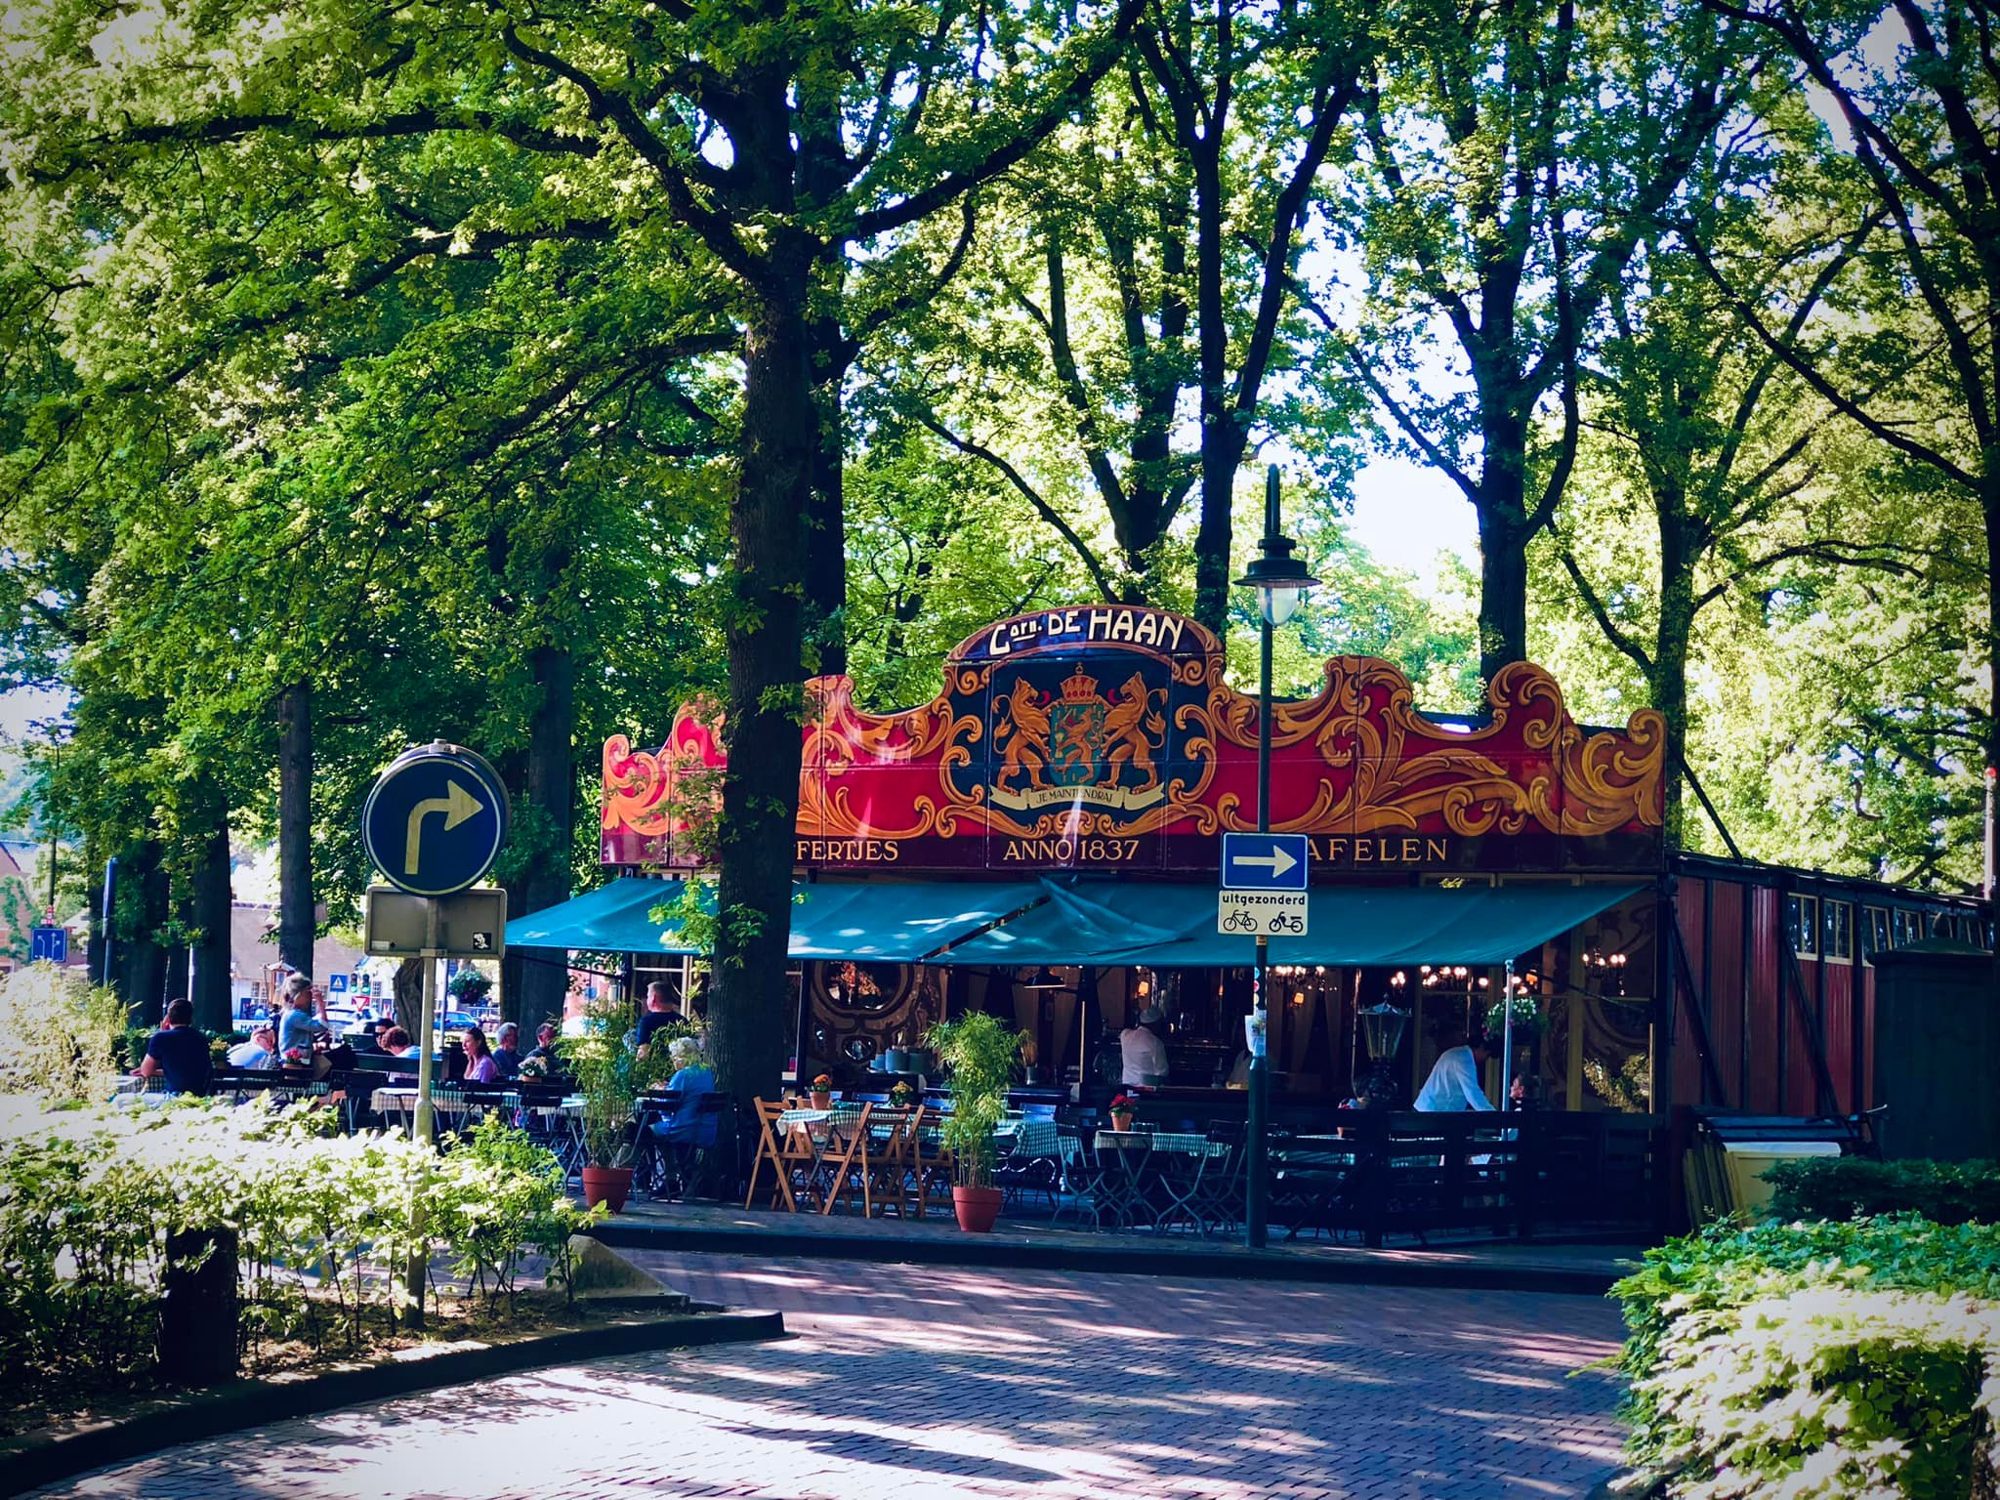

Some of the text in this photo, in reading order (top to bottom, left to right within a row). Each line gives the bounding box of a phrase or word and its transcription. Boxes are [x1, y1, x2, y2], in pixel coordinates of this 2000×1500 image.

[1047, 610, 1081, 636] DE
[1088, 609, 1184, 650] HAAN
[1036, 788, 1113, 804] JE MAINTINDRAI
[795, 840, 899, 861] FERTJES
[1003, 840, 1139, 861] ANNO 1837
[1307, 838, 1448, 862] AFELEN
[1222, 893, 1306, 907] uitgezonderd
